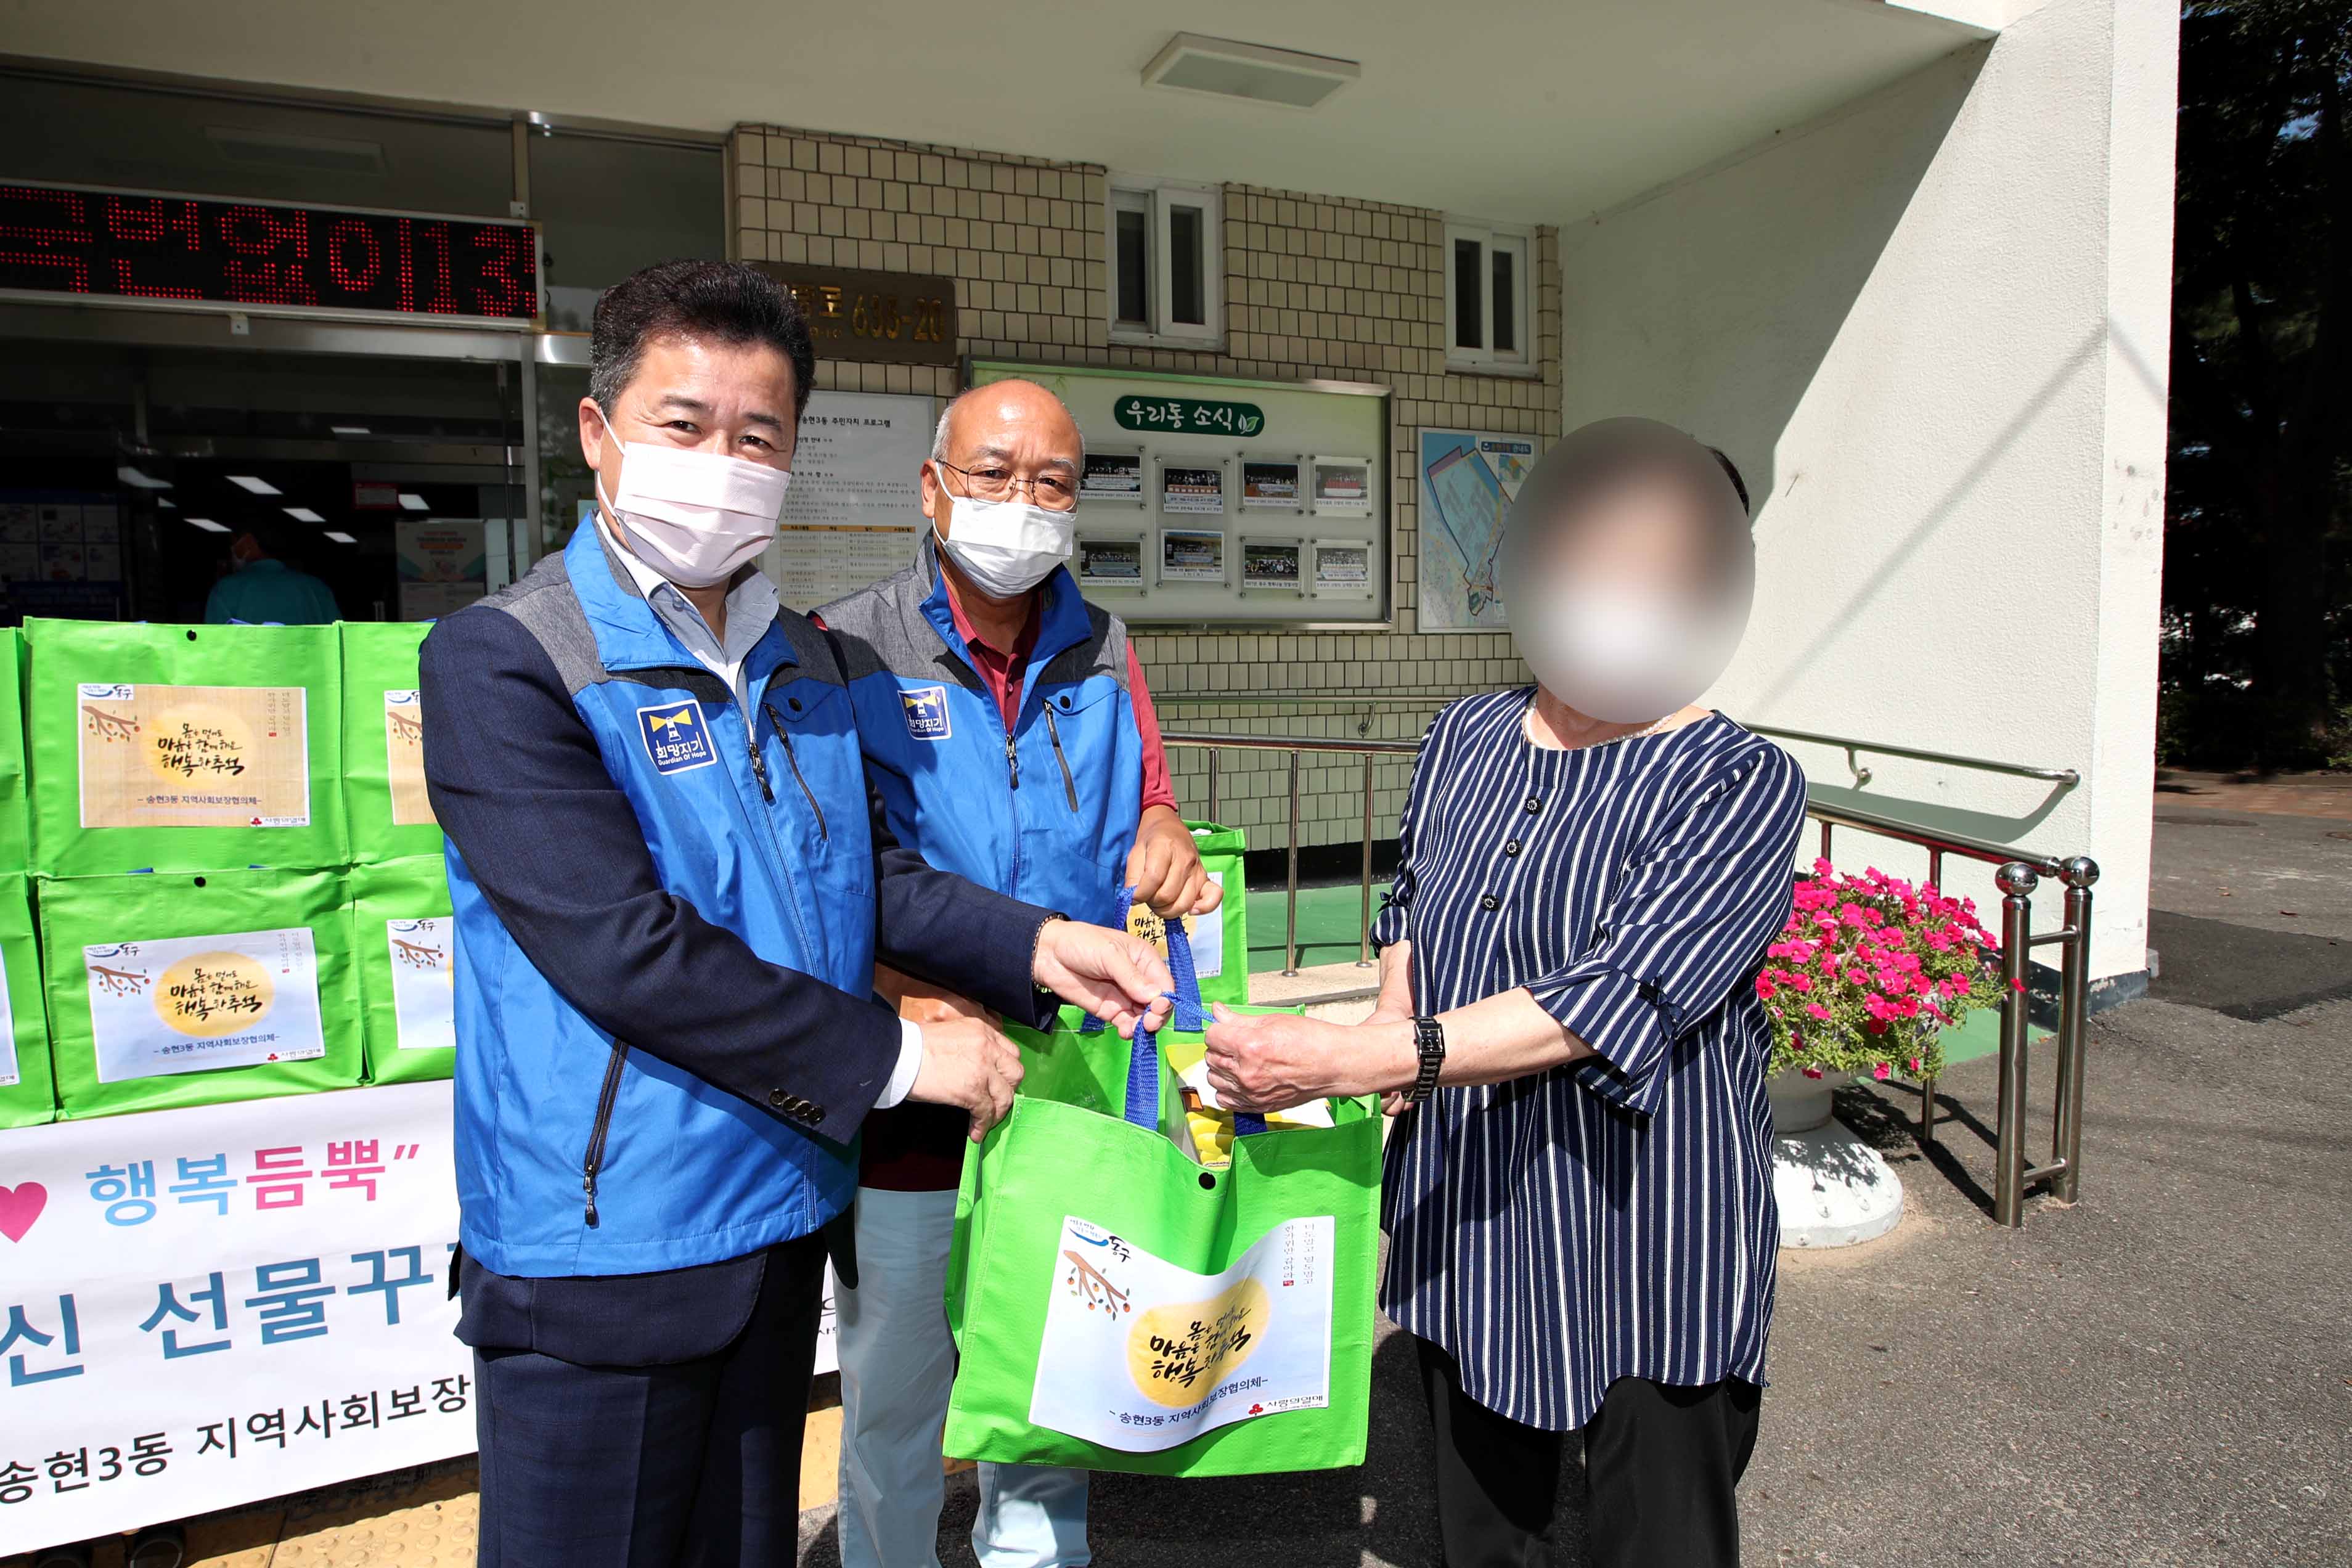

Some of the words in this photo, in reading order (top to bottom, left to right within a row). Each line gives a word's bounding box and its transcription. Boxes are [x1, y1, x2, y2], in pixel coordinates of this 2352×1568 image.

[832, 417, 859, 427] 주민자치
[864, 419, 891, 428] 프로그램
[1127, 400, 1185, 429] 우리동
[1193, 406, 1233, 431] 소식
[908, 711, 942, 729] 희망지기
[158, 738, 193, 753] 마음은
[655, 731, 704, 759] 희망지기
[658, 756, 683, 766] Guardian
[691, 751, 706, 759] Hope
[147, 794, 179, 804] 송현3동
[170, 983, 205, 998] 마음은
[162, 1043, 194, 1055] 송현3동
[1109, 1235, 1132, 1263] 동구
[138, 1241, 463, 1360] 선물꾸
[1149, 1334, 1200, 1360] 마음은
[1119, 1410, 1165, 1427] 송현3동
[0, 1431, 174, 1505] 송현3동
[196, 1373, 472, 1459] 지역사회보장
